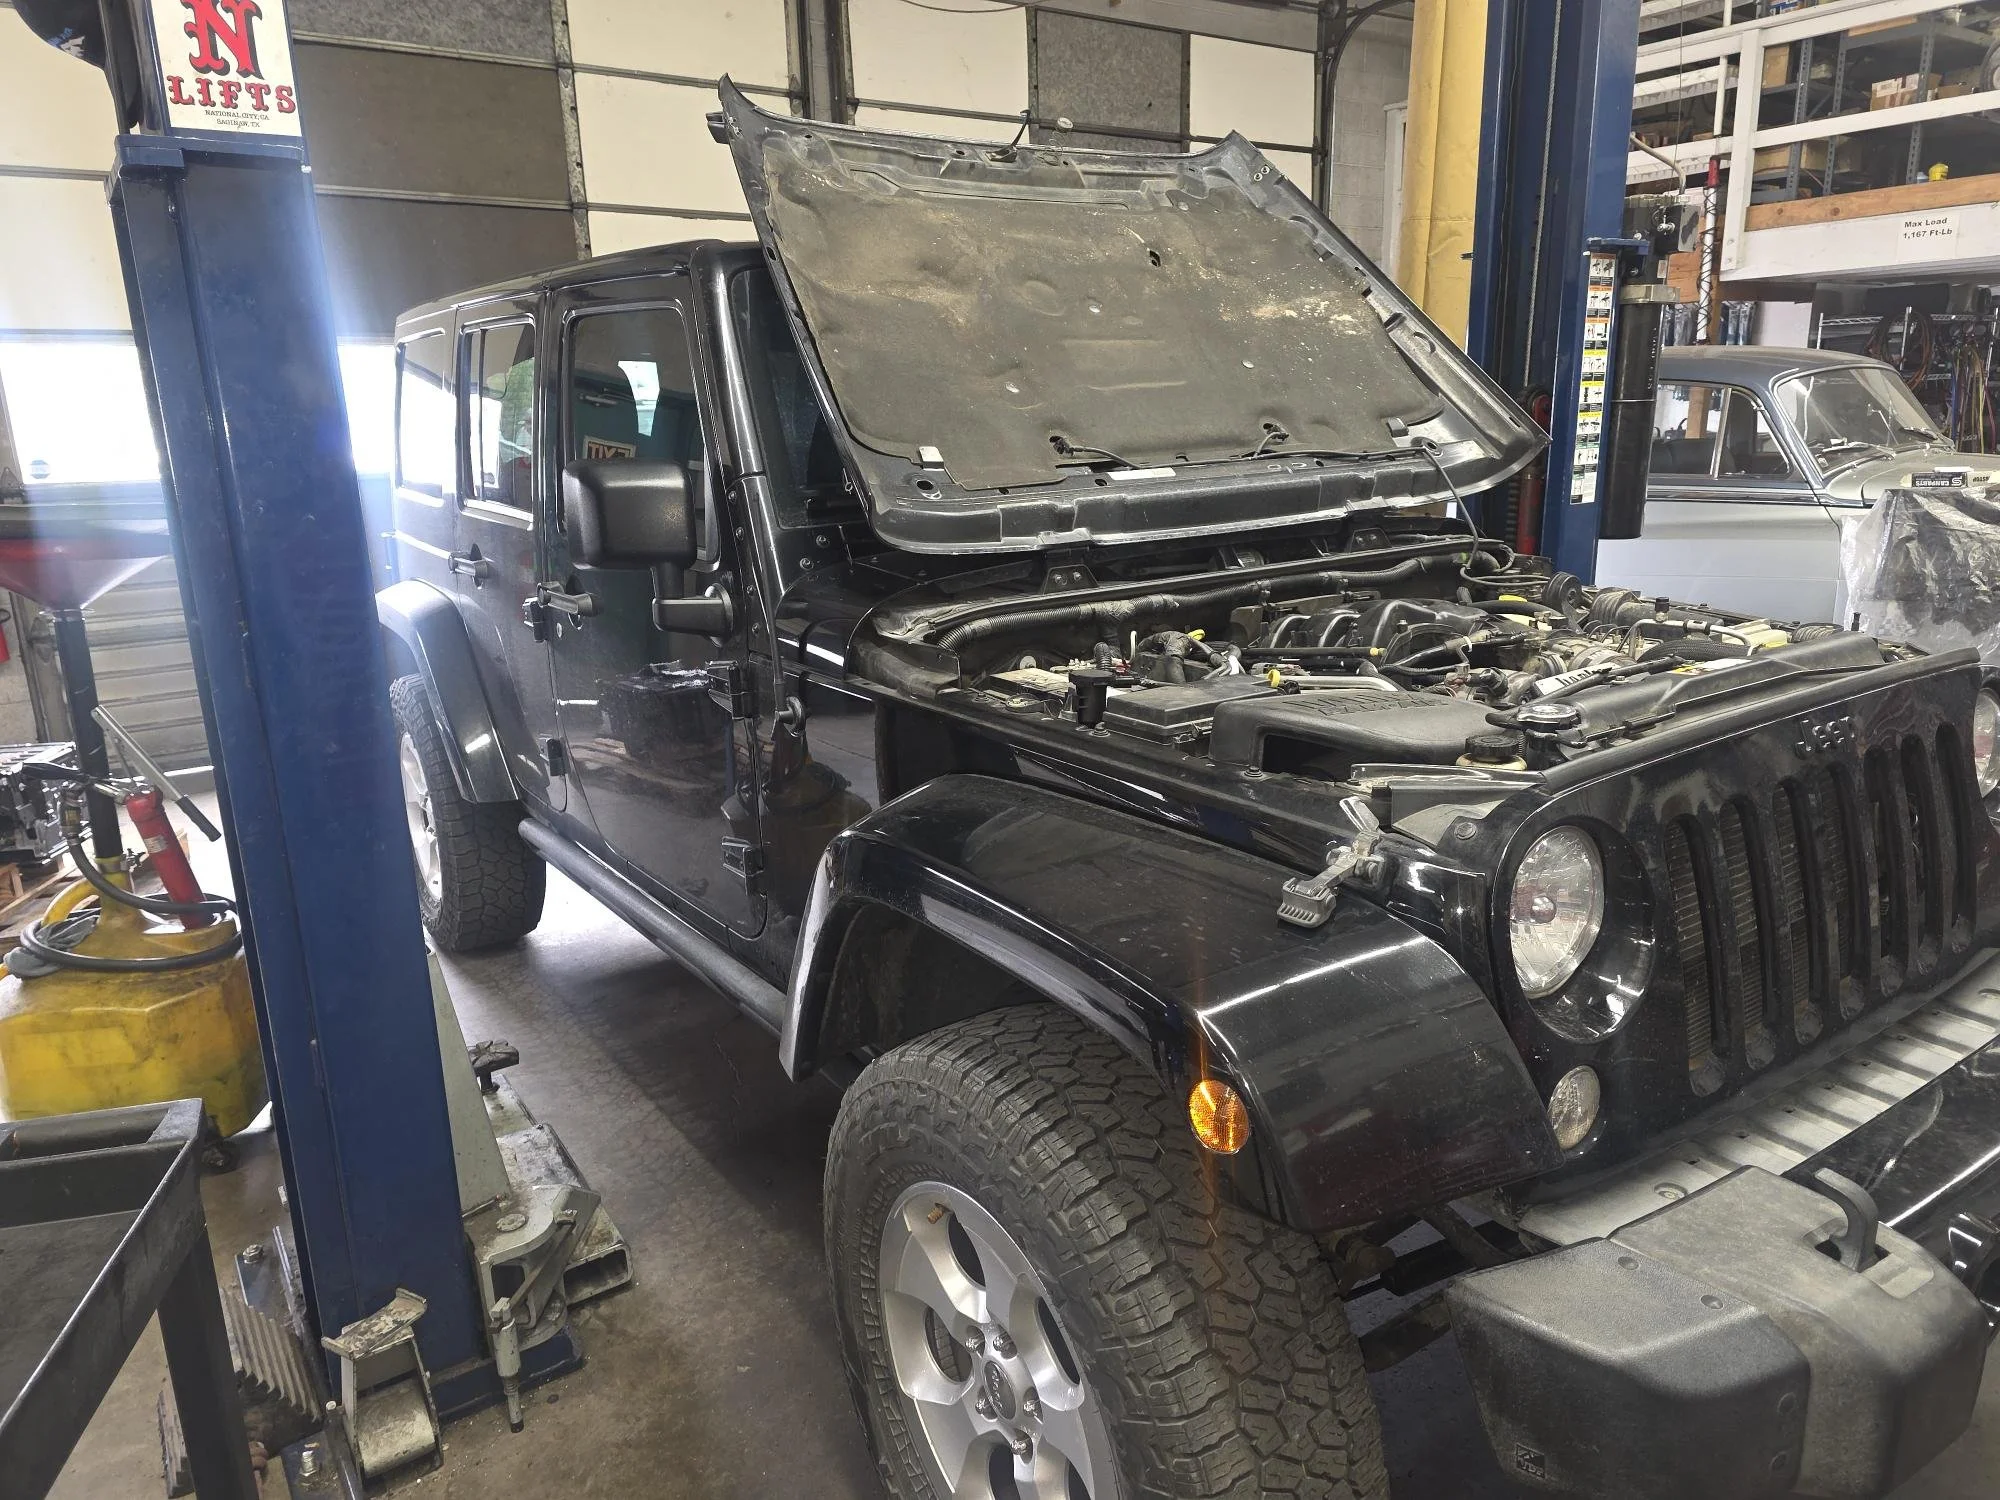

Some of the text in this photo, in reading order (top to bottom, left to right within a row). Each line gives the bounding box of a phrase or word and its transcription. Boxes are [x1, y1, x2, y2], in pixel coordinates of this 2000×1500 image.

[166, 75, 297, 114] LIFTS
[204, 109, 240, 119] NATIONAL
[1904, 217, 1948, 228] Max Load
[1903, 228, 1953, 239] 1,167 Ft-Lb
[1794, 716, 1855, 758] Jeep
